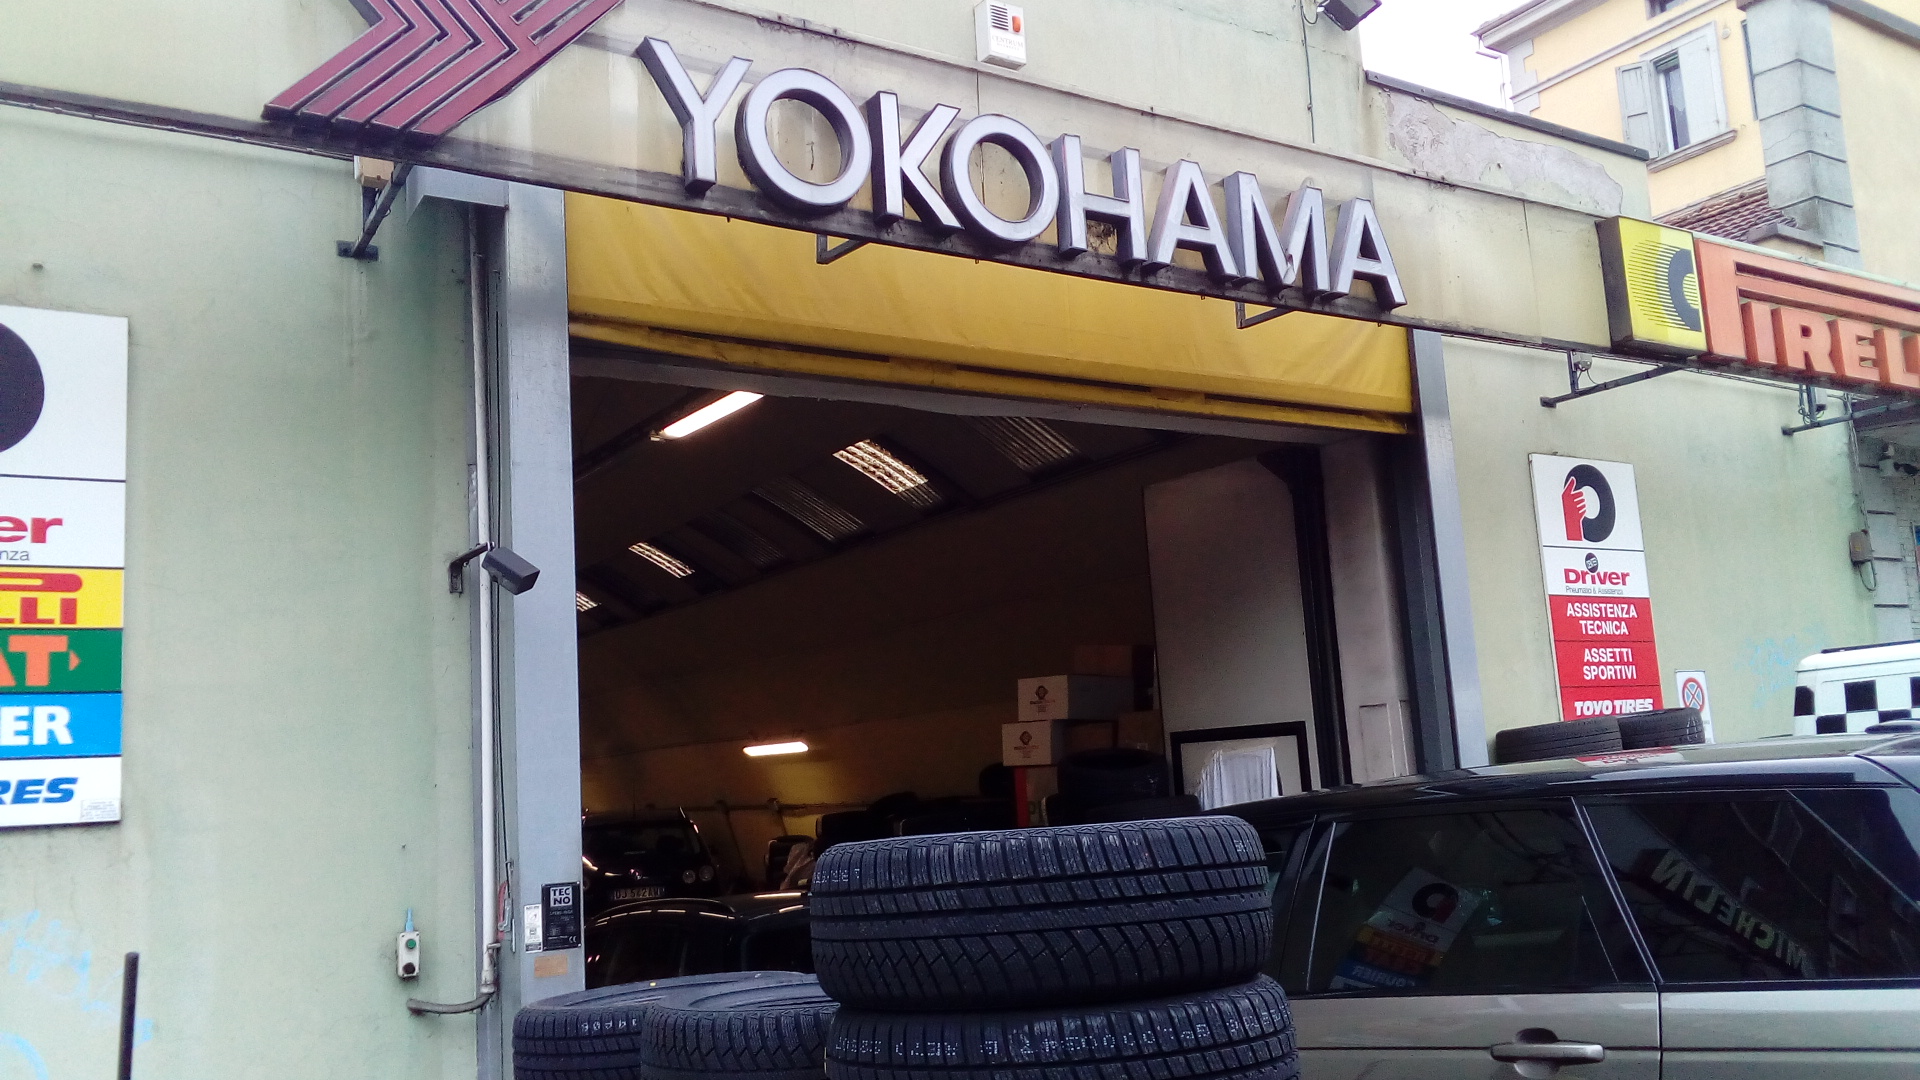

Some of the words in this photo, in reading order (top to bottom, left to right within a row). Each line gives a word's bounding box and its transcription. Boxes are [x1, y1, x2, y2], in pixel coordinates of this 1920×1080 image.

[635, 36, 1407, 311] YOKOHAMA
[1695, 238, 1920, 389] PIREL
[1563, 568, 1630, 586] Driver
[1566, 602, 1637, 618] ASSISTENZA
[1579, 620, 1628, 635] TECNICA
[1583, 647, 1633, 663] ASSETTI
[1583, 664, 1636, 680] SPORTIVI
[1574, 700, 1613, 716] TOYO
[1614, 698, 1653, 714] TIRES
[552, 887, 570, 896] TEC
[553, 896, 571, 905] NO
